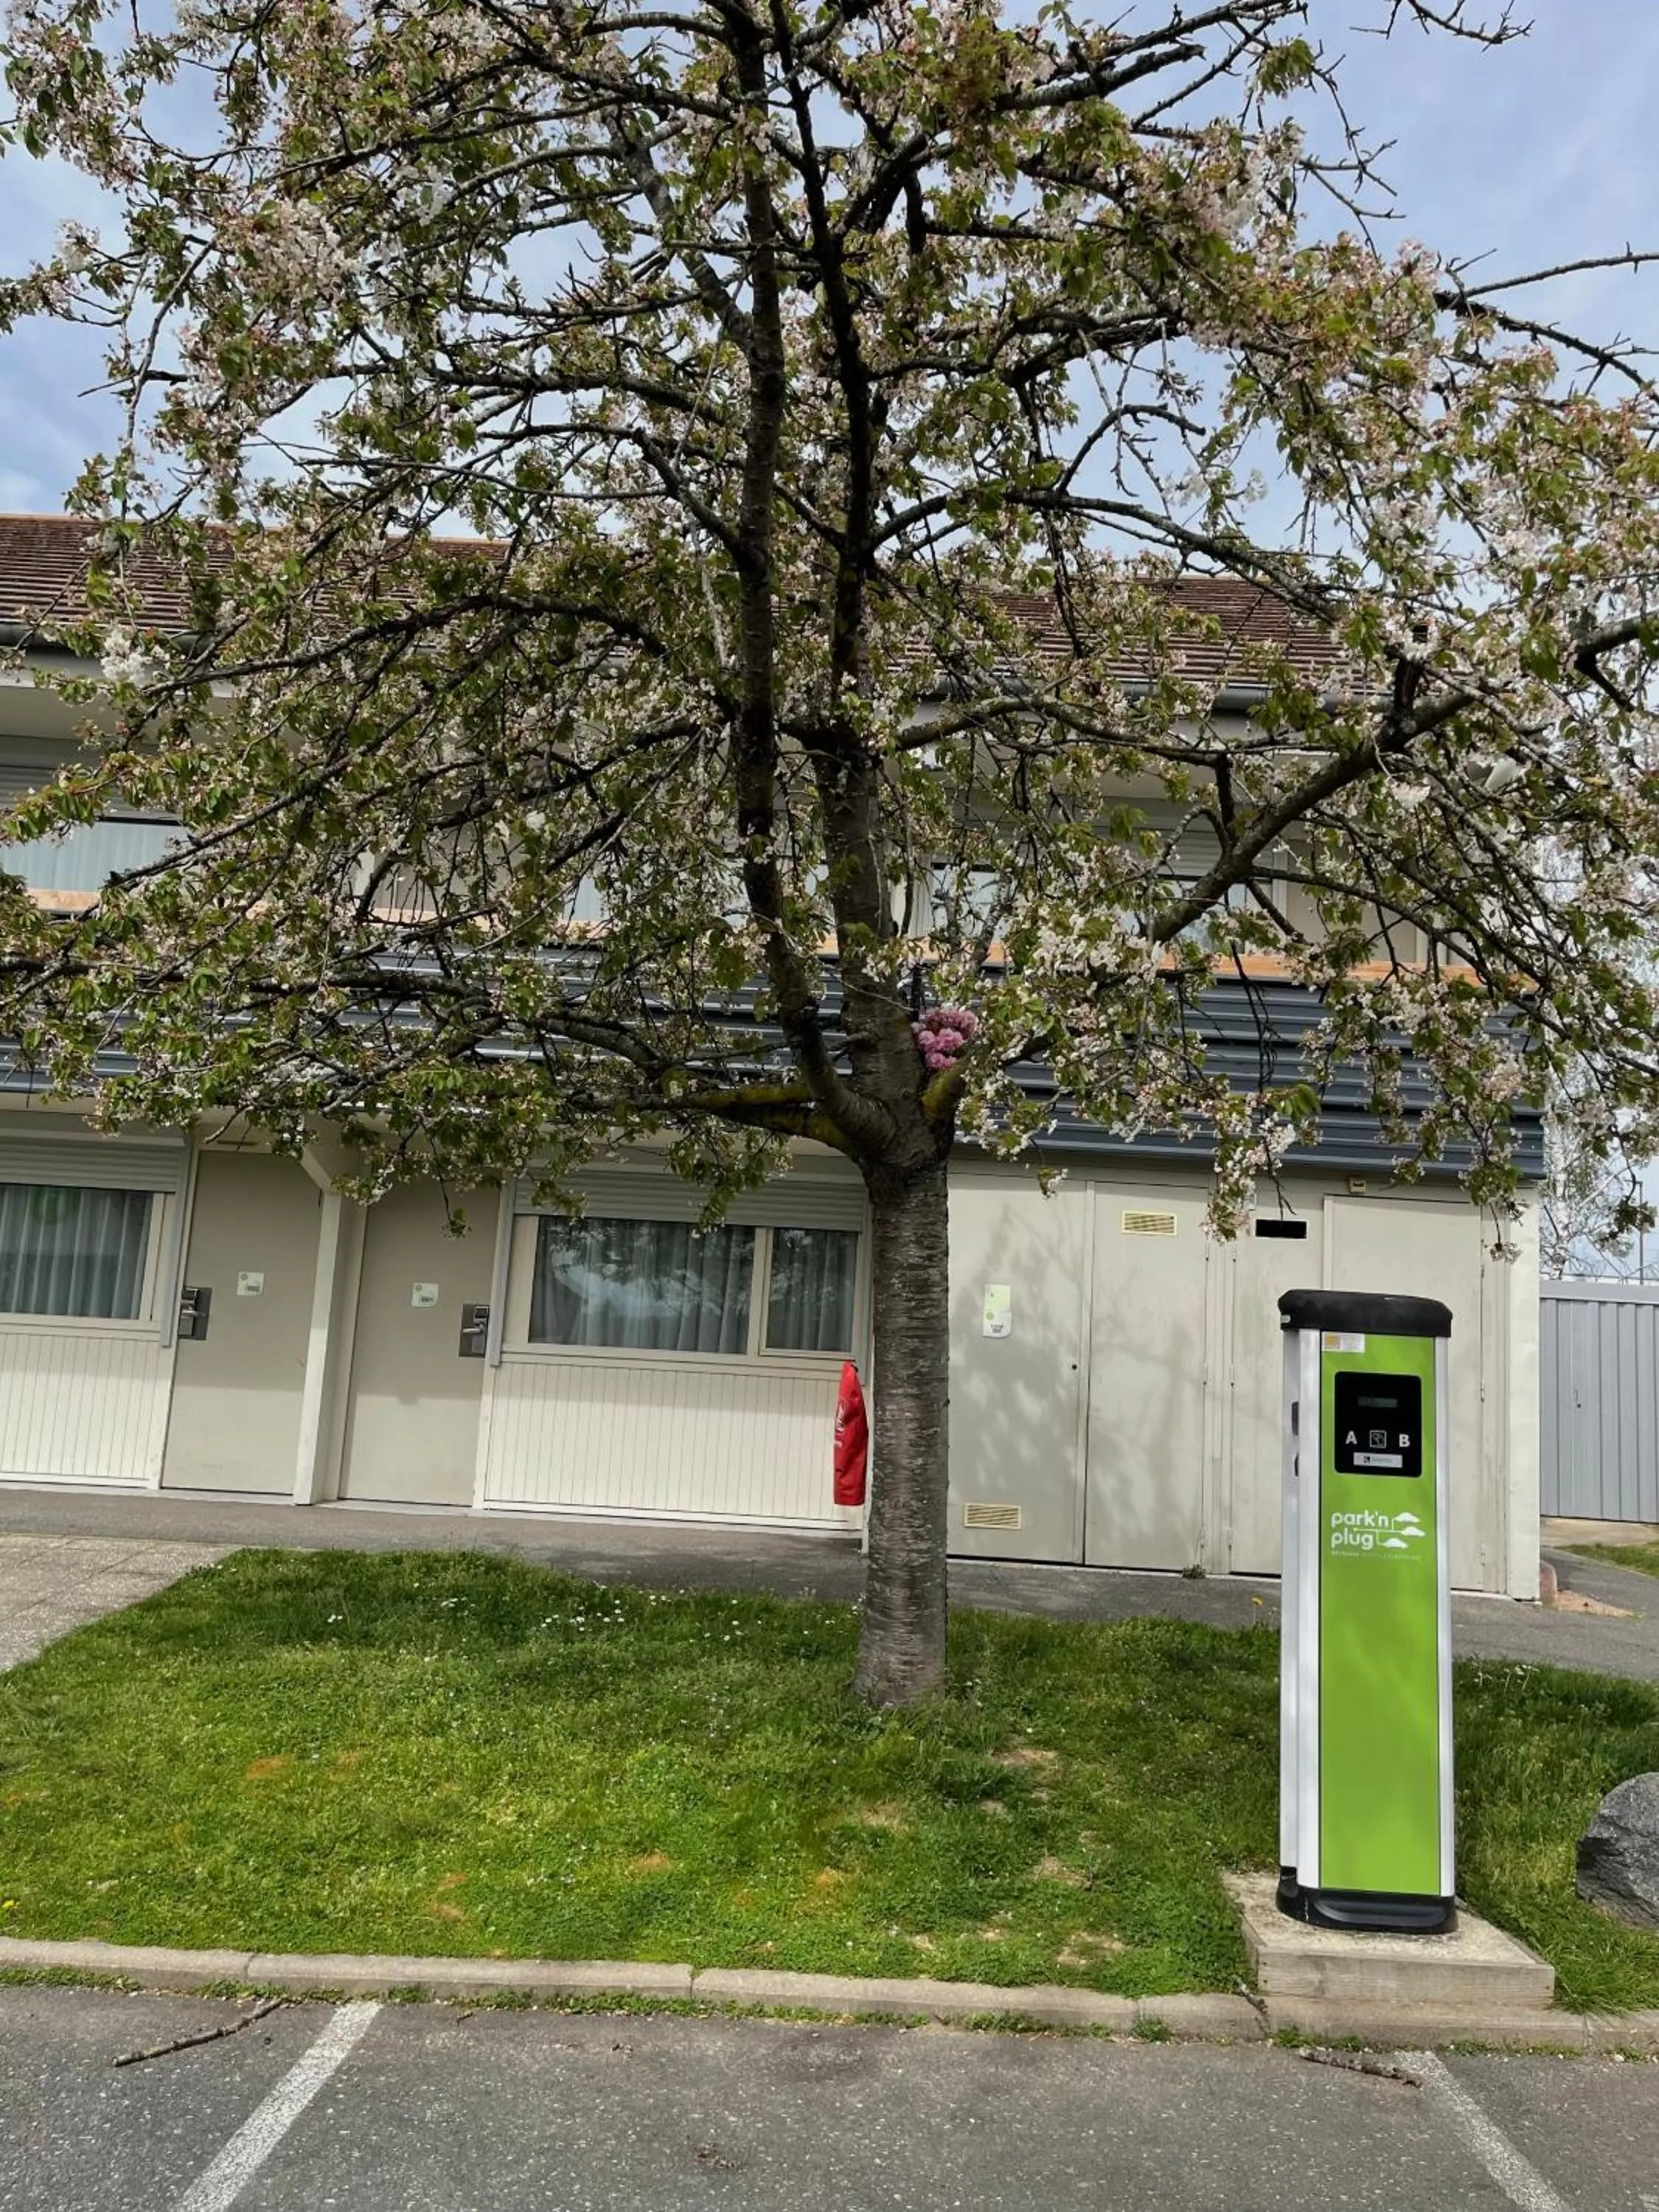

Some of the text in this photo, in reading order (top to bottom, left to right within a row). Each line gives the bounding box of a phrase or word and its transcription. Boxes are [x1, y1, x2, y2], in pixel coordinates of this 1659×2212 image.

[1345, 1430, 1357, 1444] A
[1399, 1433, 1410, 1447] B
[1331, 1509, 1389, 1528] park'n
[1331, 1527, 1374, 1551] plug
